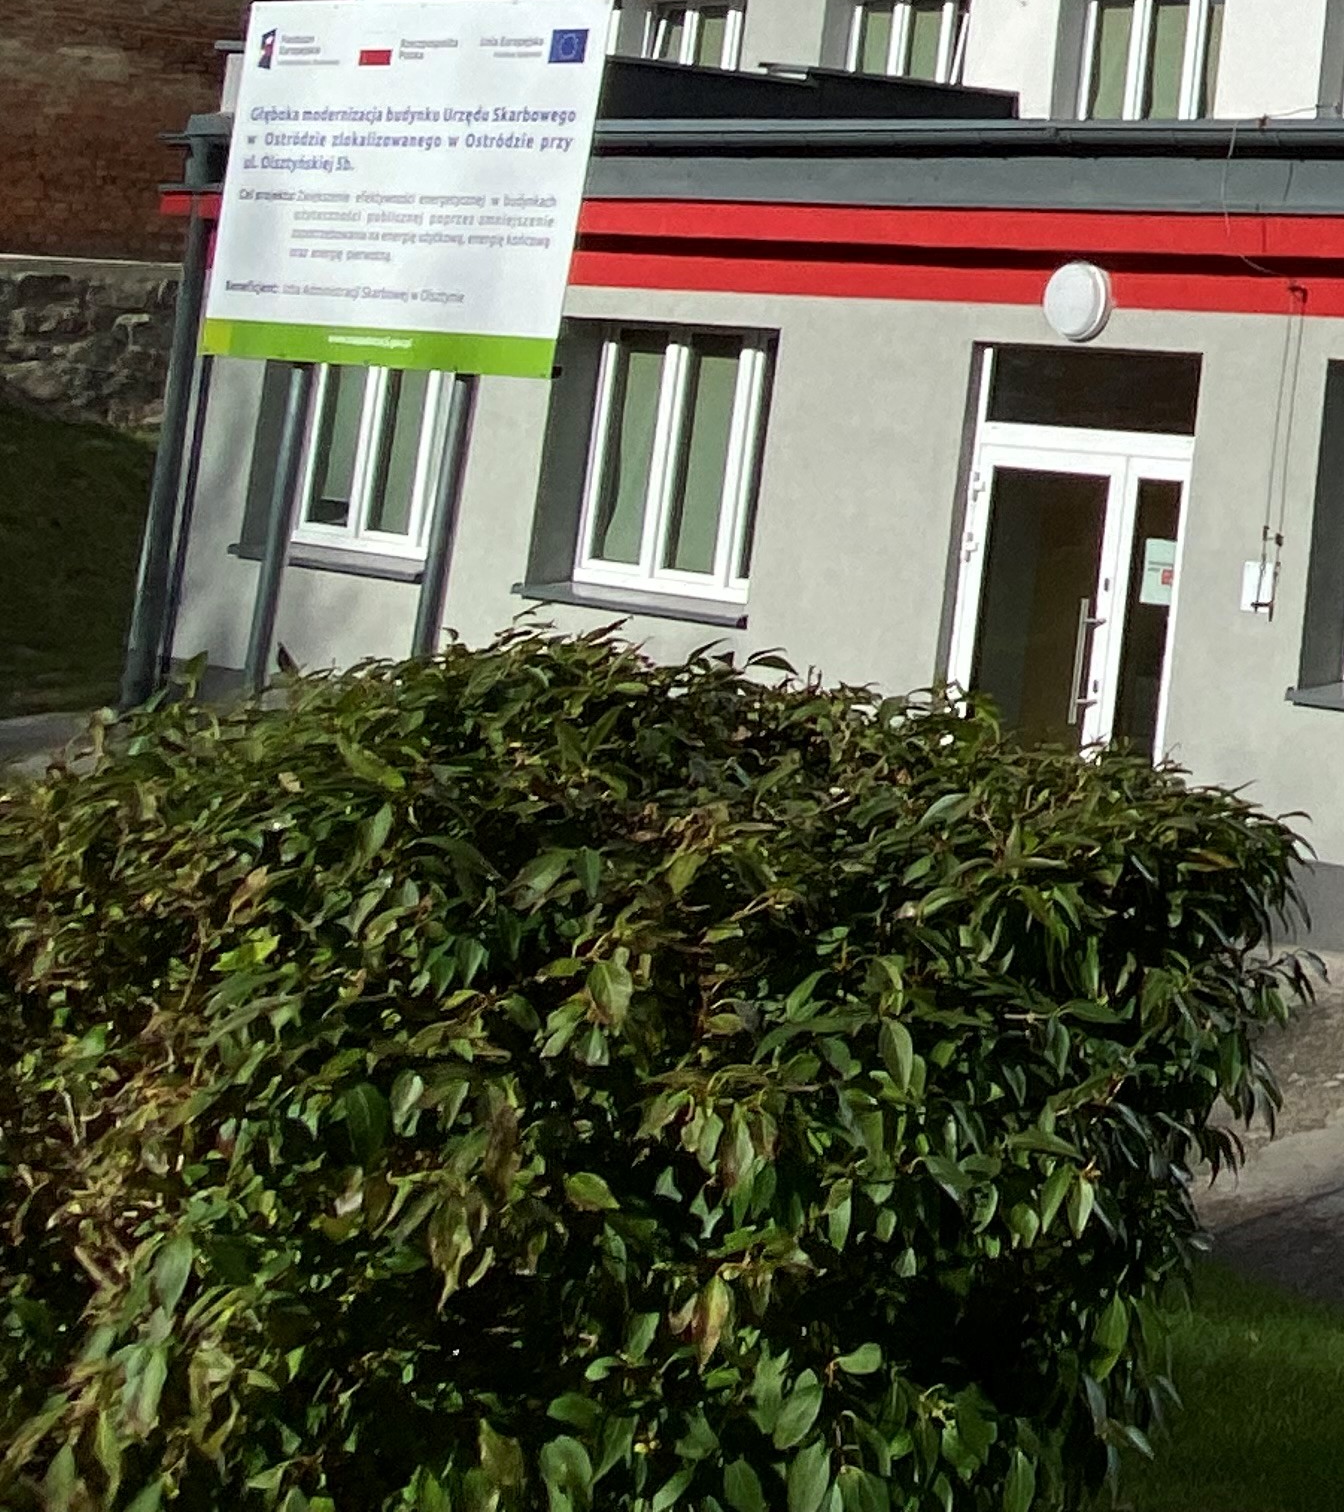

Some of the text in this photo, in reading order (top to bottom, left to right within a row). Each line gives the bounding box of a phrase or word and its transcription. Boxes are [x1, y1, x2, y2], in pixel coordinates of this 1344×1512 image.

[302, 106, 383, 124] modernizacja
[385, 106, 440, 125] budynku
[443, 105, 490, 126] Urzędu
[491, 105, 577, 126] Skarbowego
[264, 132, 327, 147] Ostródzie
[331, 131, 442, 150] zlokalizowanego
[448, 137, 460, 148] w
[465, 133, 535, 149] Ostródzie
[539, 137, 574, 152] przy
